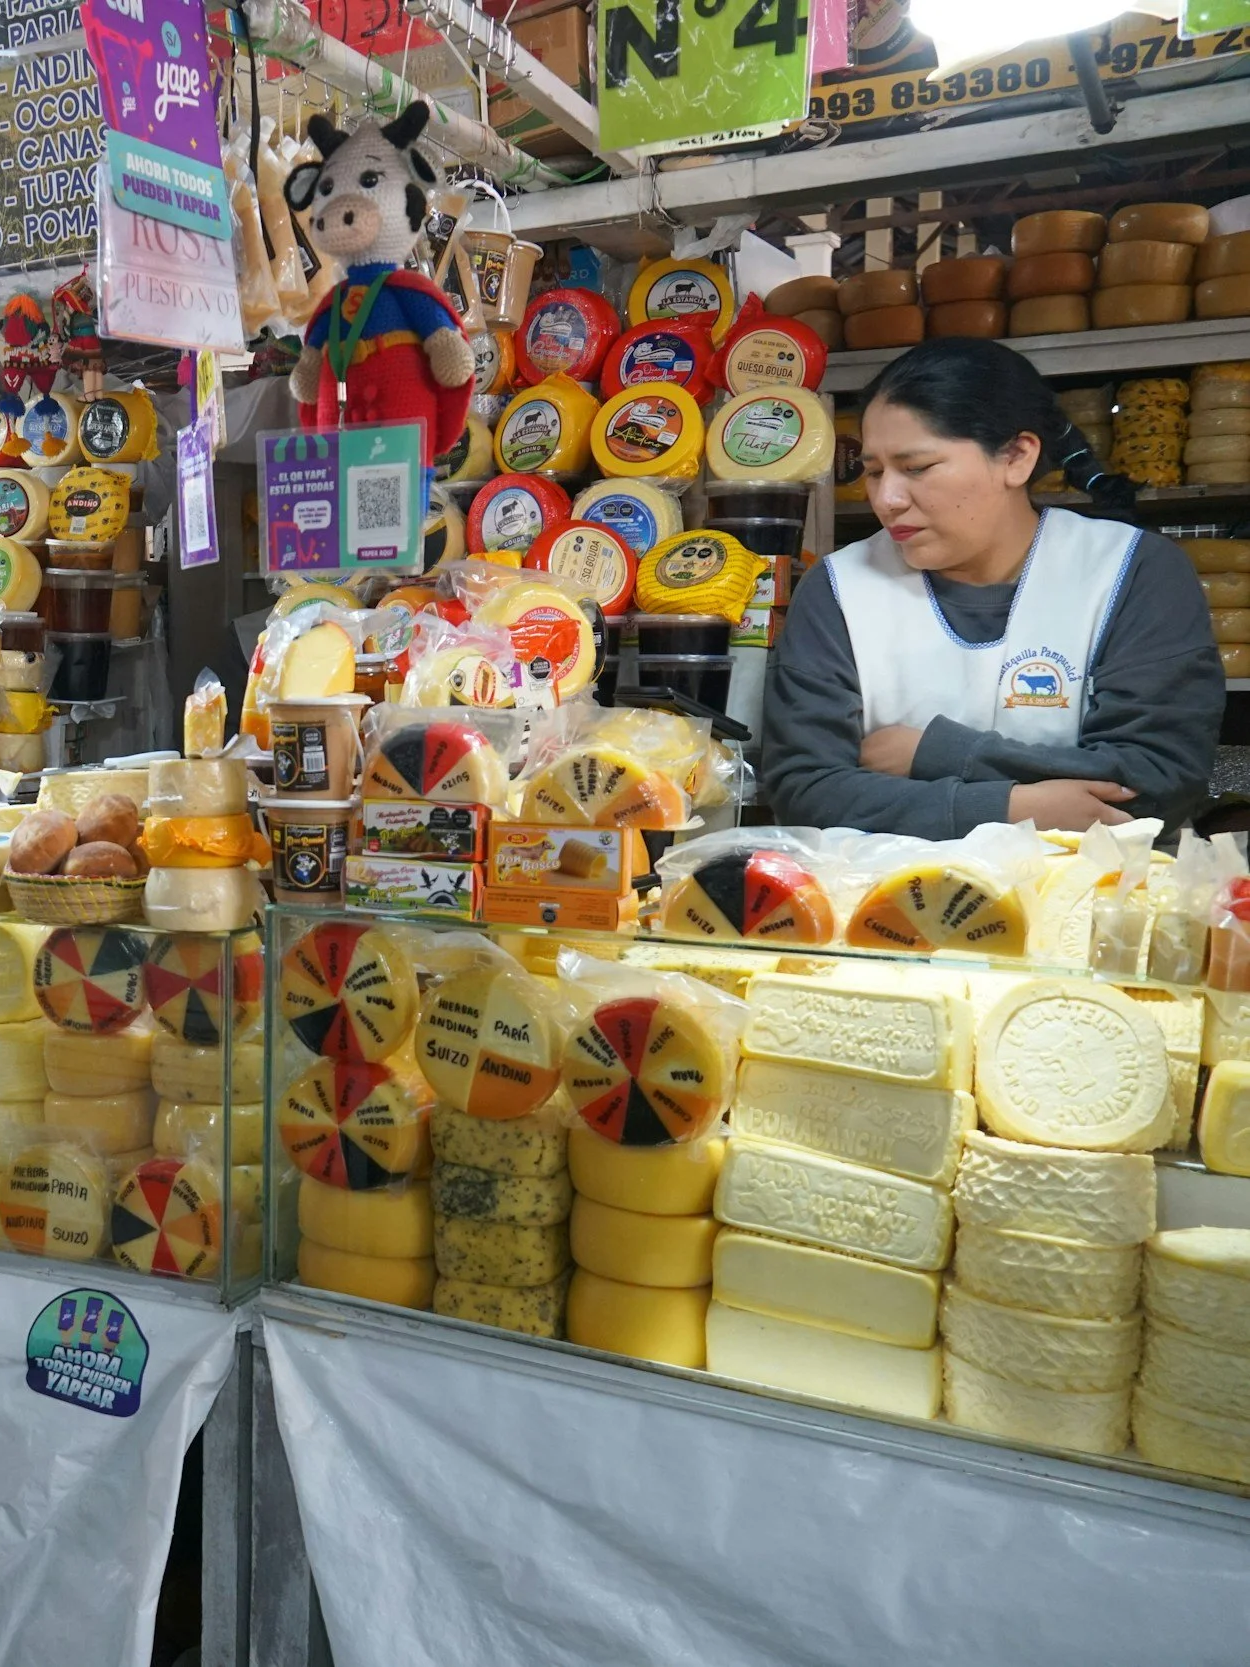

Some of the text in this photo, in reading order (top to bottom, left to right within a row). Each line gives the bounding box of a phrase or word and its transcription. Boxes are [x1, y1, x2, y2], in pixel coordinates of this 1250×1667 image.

[154, 61, 200, 122] yape
[889, 57, 1051, 111] 853380
[126, 152, 213, 198] AHORA TODOS
[123, 172, 221, 222] PUEDEN YAPEAR
[125, 272, 194, 310] PUESTO
[737, 361, 793, 378] QUESO GOUDA
[278, 471, 289, 482] EL
[304, 468, 327, 480] YAPE
[292, 483, 306, 494] EN
[306, 480, 336, 493] TODAS
[503, 534, 526, 549] GOUDA
[586, 540, 601, 569] GOUDA
[371, 772, 403, 795] ANDINO
[441, 770, 471, 791] SUIZO
[535, 788, 566, 814] SUIZO
[495, 853, 561, 873] Don Bosco
[685, 908, 716, 936] SUIZO
[966, 919, 1009, 943] SUIZO
[285, 991, 316, 1008] SUIZO
[438, 998, 480, 1019] HIERBAS
[429, 1015, 479, 1040] ANDINAS
[650, 1025, 676, 1056] SUIZO
[426, 1039, 470, 1068] SUIZO
[480, 1057, 533, 1086] ANDINO
[288, 1097, 316, 1120] PARIA
[362, 1133, 391, 1152] SUIZO
[52, 1227, 89, 1246] SUIZO
[51, 1345, 122, 1376] AHORA
[34, 1357, 132, 1395] TODOS PUEDEN
[45, 1370, 116, 1410] YAPEAR
